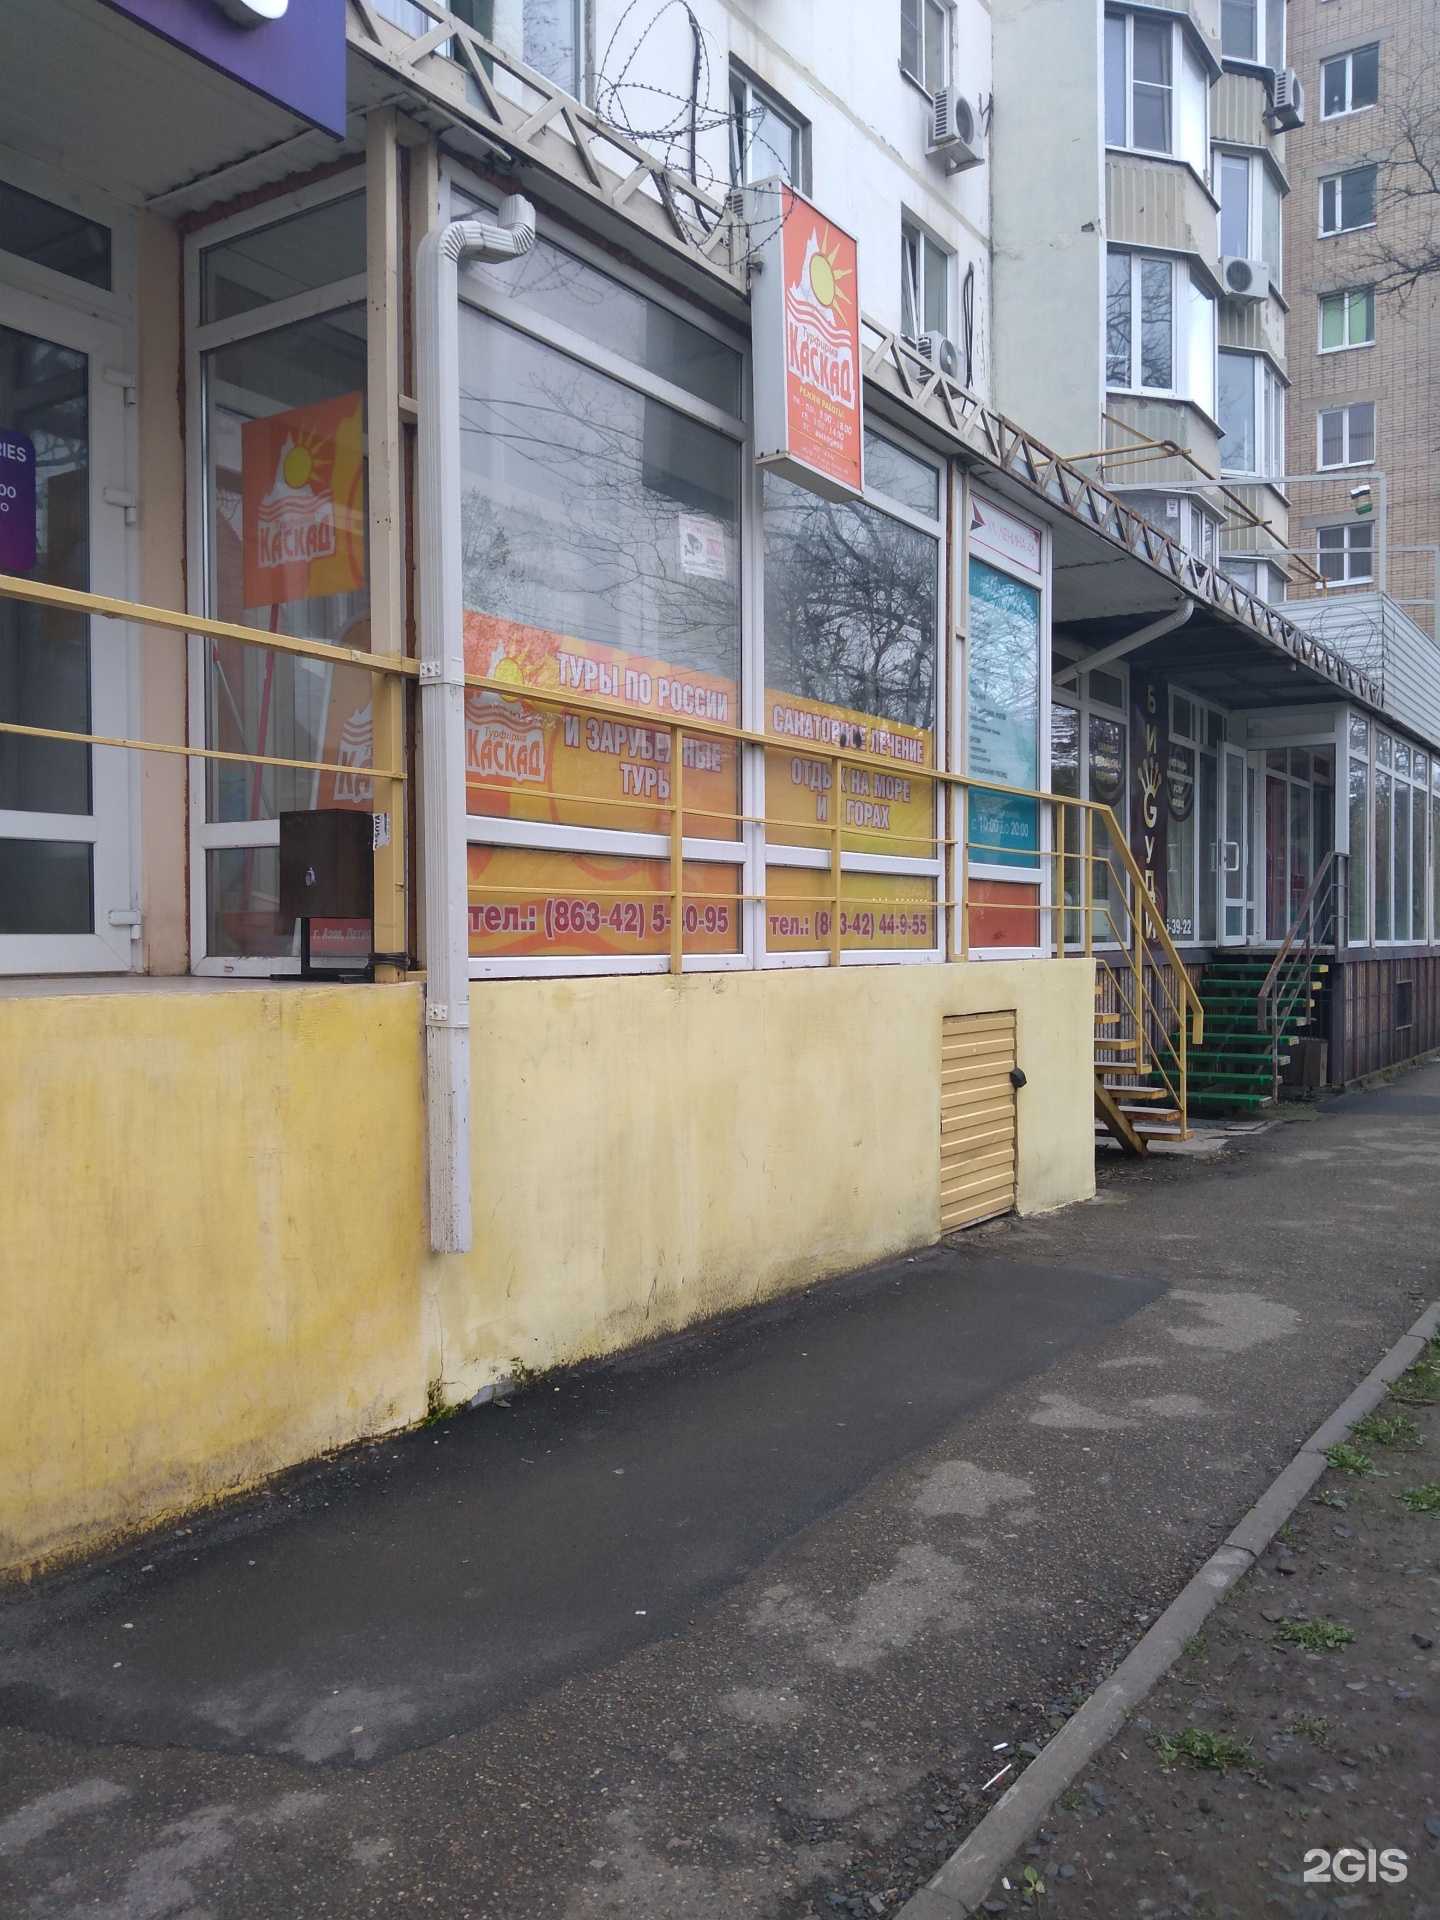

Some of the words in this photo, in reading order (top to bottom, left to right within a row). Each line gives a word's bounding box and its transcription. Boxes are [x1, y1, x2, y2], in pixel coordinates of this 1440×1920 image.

[789, 321, 852, 402] КАСКАД
[260, 522, 331, 564] КАСКАД
[556, 651, 619, 697] ТУРЫ
[625, 668, 652, 704] ПО
[658, 676, 728, 721] РОССИИ
[467, 729, 541, 776] КАСКАД
[564, 713, 580, 747] И
[586, 717, 721, 772] ЗАРУБЕНЫЕ
[871, 728, 924, 764] ЛЕЧЕНИЕ
[851, 768, 869, 796] НА
[874, 773, 911, 803] МОРЕ
[816, 795, 828, 822] И
[846, 799, 890, 830] ГОРАХ
[468, 904, 537, 932] тел.:
[545, 898, 646, 940] (863-42)
[652, 903, 729, 934] 5-0-95
[769, 914, 809, 936] тел.:
[814, 911, 875, 940] (83-42)
[879, 912, 927, 936] 44-9-55
